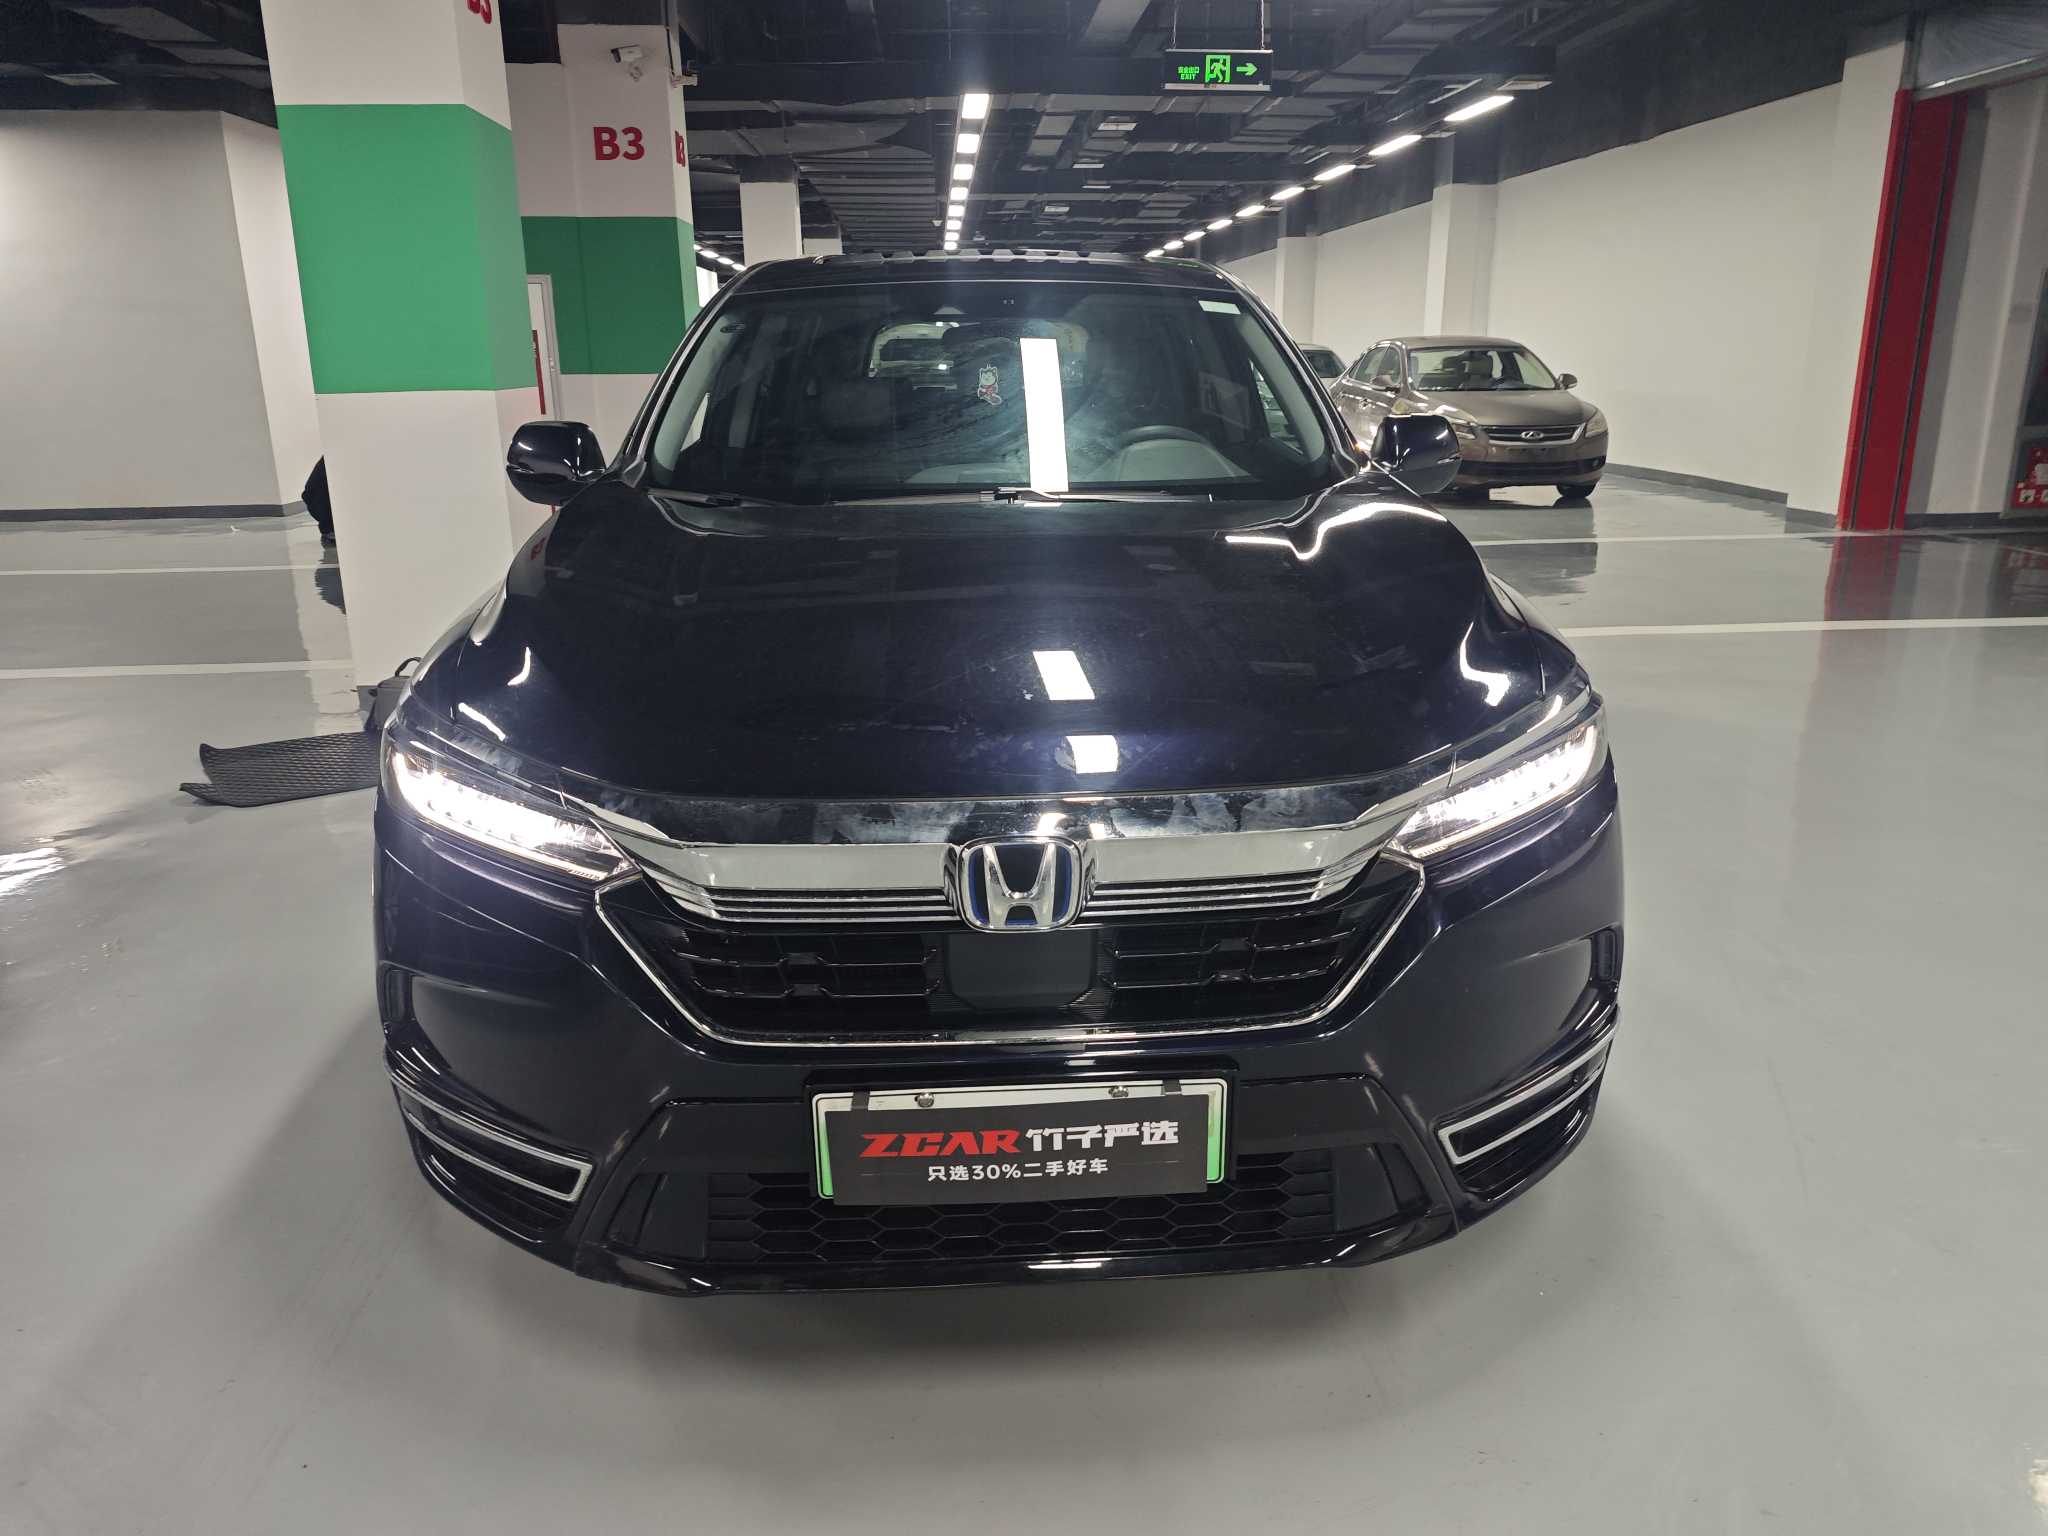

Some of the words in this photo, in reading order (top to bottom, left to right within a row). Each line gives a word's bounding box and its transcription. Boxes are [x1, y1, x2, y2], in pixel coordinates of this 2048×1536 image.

[593, 126, 645, 161] B3
[860, 1129, 1021, 1157] ZCAR
[1025, 1120, 1179, 1152] 竹子严选
[927, 1157, 1109, 1182] 只选30%二手好车
